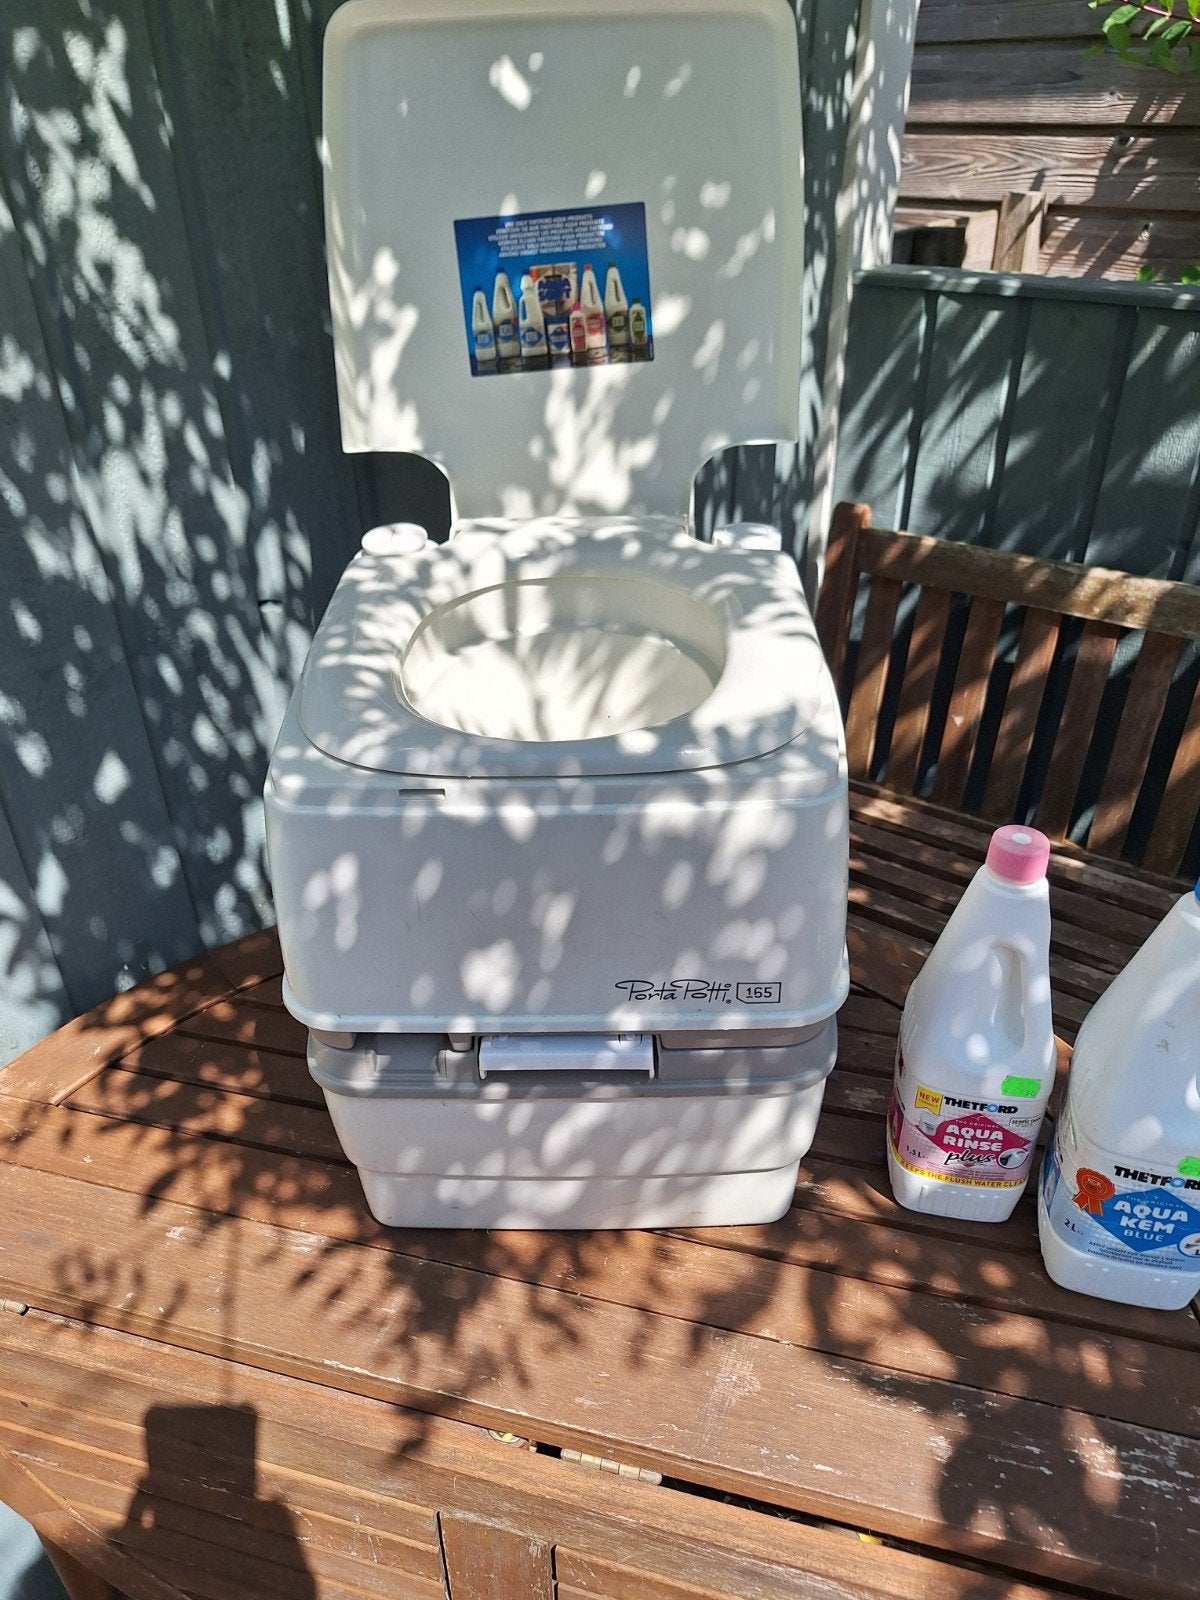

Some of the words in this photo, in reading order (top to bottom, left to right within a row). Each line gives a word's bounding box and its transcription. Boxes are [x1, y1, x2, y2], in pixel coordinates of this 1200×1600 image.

[615, 979, 677, 1001] Porta
[745, 986, 772, 999] 165
[918, 1091, 940, 1104] NEW
[943, 1096, 1019, 1114] THETFORD
[945, 1124, 1004, 1141] AQUA
[942, 1135, 1003, 1152] RINSE
[943, 1149, 996, 1166] plus
[900, 1159, 925, 1176] KEEPS
[926, 1171, 942, 1182] THE
[944, 1175, 973, 1187] FLUSH
[974, 1180, 1002, 1188] WATER
[1114, 1165, 1200, 1191] THETFOR
[1113, 1200, 1189, 1222] AQUA
[1120, 1216, 1176, 1234] KEM
[1123, 1229, 1164, 1242] BLUE
